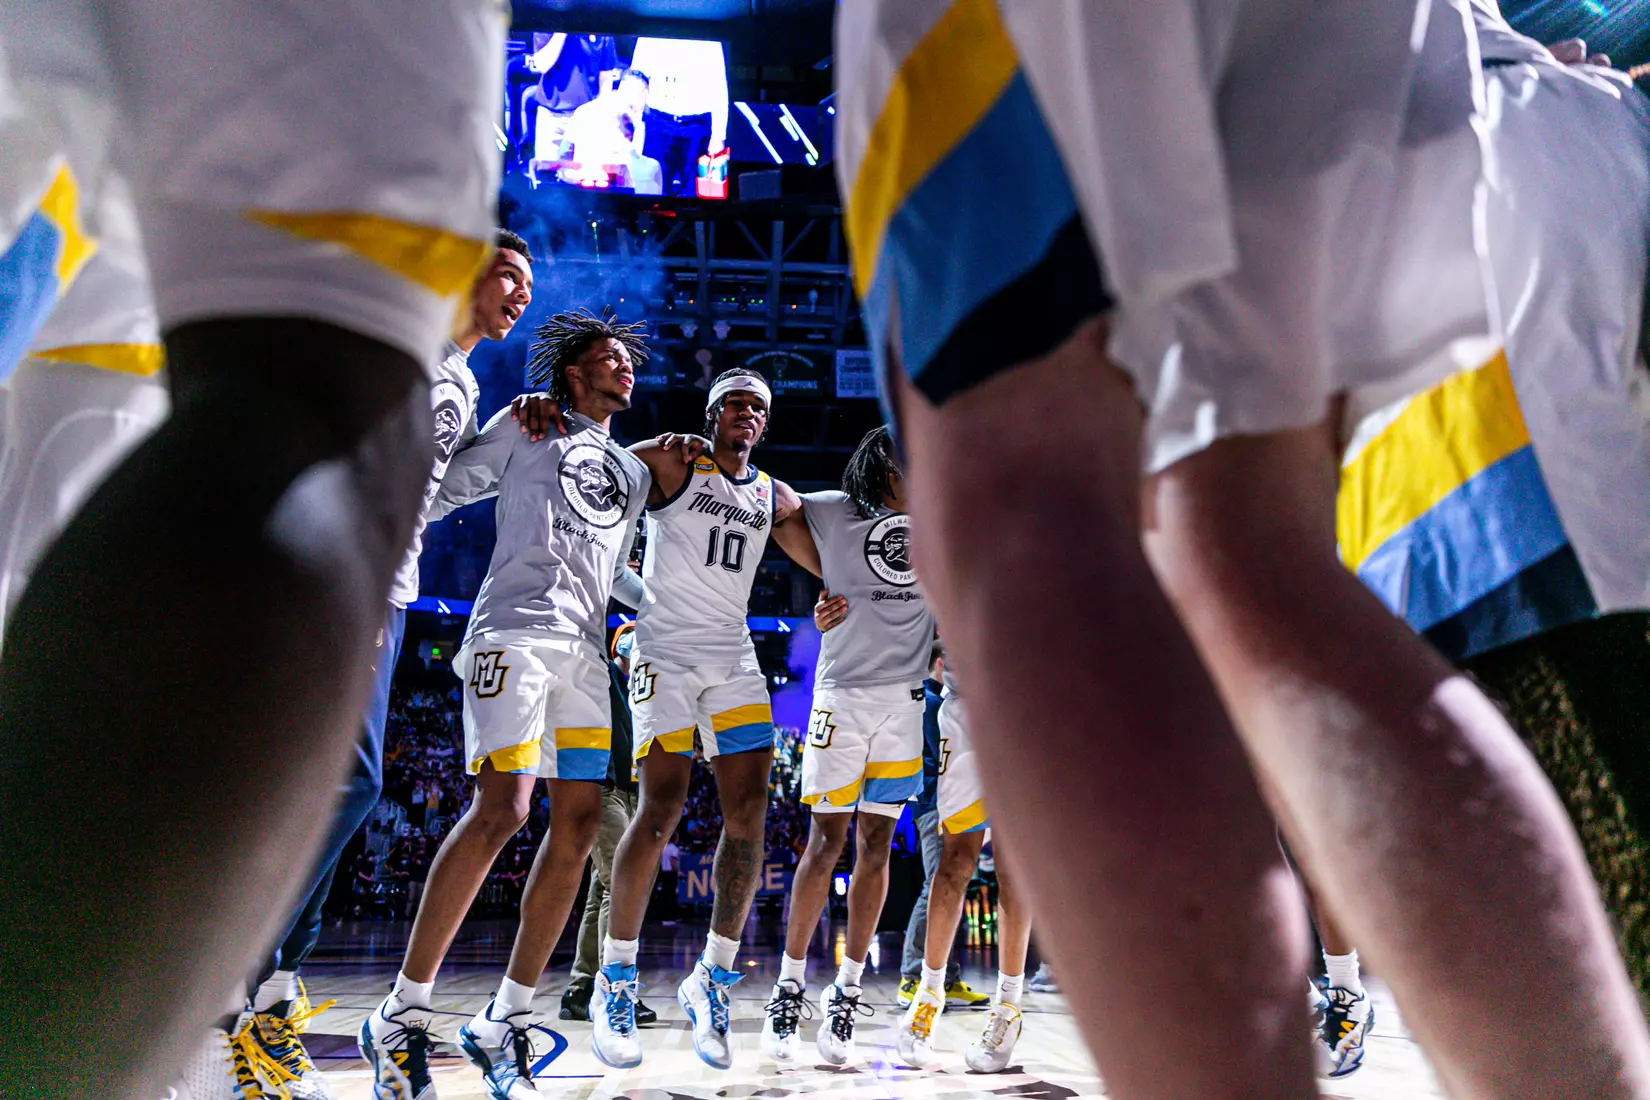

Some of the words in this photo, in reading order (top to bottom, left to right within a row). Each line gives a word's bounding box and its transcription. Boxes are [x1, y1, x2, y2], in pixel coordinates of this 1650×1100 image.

[687, 491, 768, 531] Marquette
[883, 518, 908, 529] MILWA
[704, 525, 748, 574] 10
[873, 557, 898, 580] COLORED
[870, 590, 904, 602] Black
[469, 650, 511, 699] MU
[630, 662, 659, 705] MU
[808, 708, 837, 750] MU
